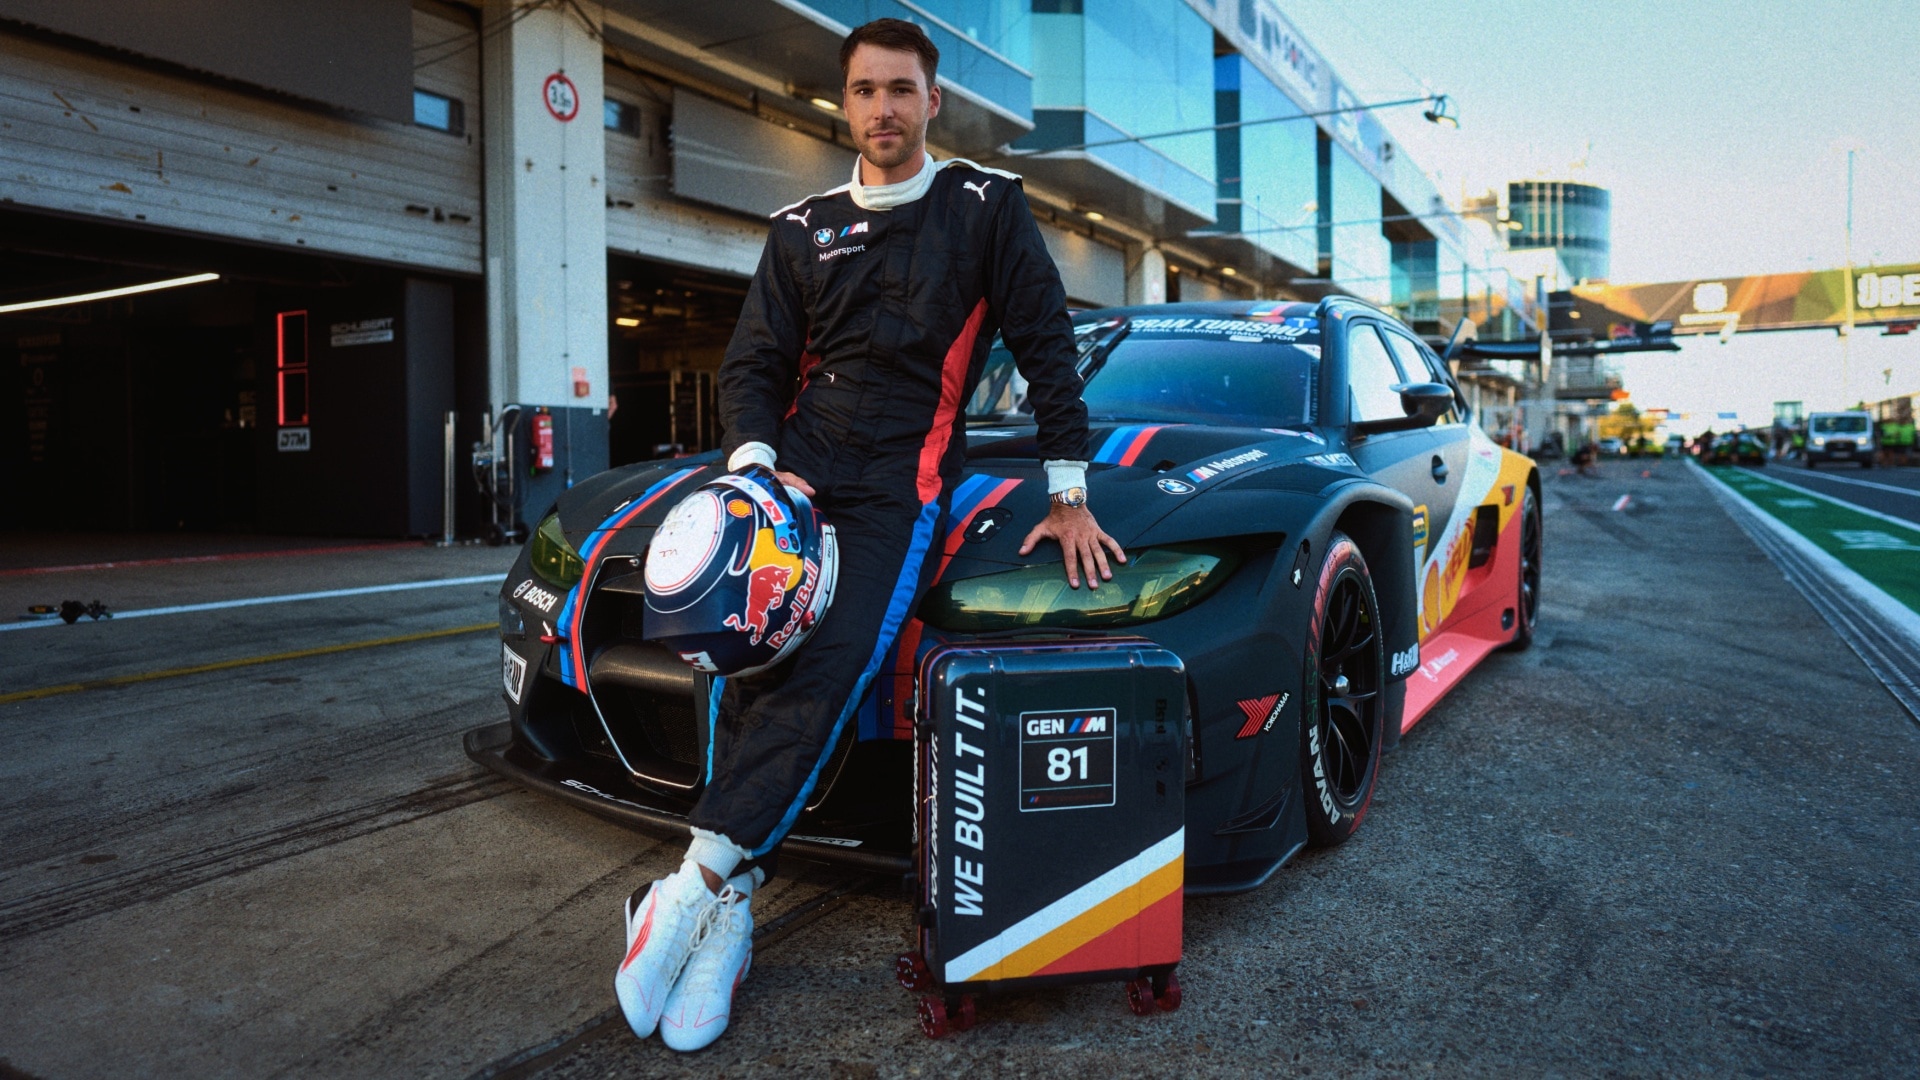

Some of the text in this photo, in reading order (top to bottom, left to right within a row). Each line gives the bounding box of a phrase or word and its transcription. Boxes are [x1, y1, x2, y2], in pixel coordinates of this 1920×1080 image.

[819, 244, 866, 261] Motorsport
[1131, 319, 1190, 330] GRAN
[1199, 319, 1309, 337] TURISMO
[1210, 448, 1269, 471] Motorsport
[523, 586, 558, 612] BOSCH
[766, 556, 820, 649] Red Bull
[1027, 719, 1065, 735] GEN
[1263, 692, 1290, 732] YOKOHAMA
[1047, 746, 1088, 782] 81
[1309, 725, 1341, 825] ADVAN
[954, 687, 985, 916] WE BUILT IT.
